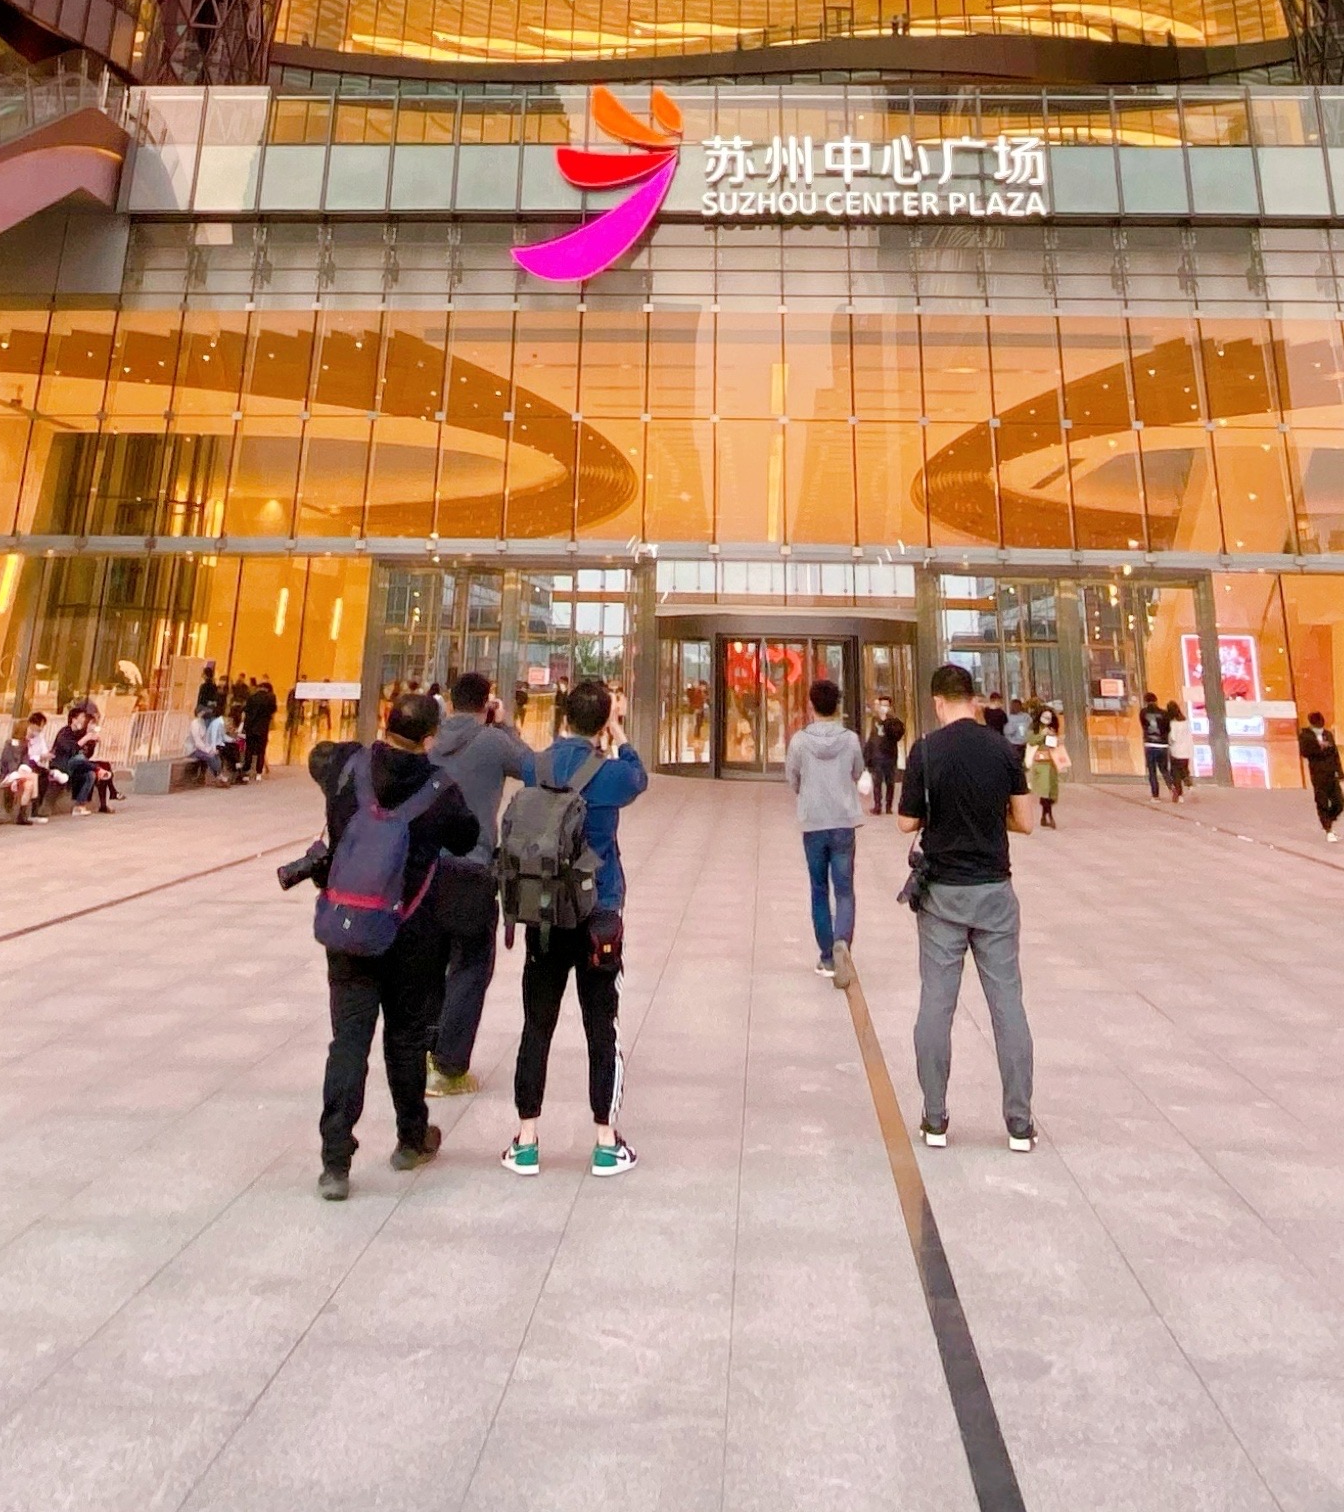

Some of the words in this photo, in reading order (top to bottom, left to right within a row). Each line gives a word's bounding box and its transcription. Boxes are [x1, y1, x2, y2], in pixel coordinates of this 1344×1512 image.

[702, 135, 1046, 186] 苏州中心广场
[701, 191, 817, 215] SUZHOU
[825, 191, 939, 215] CENTER
[949, 191, 1047, 216] PLAZA
